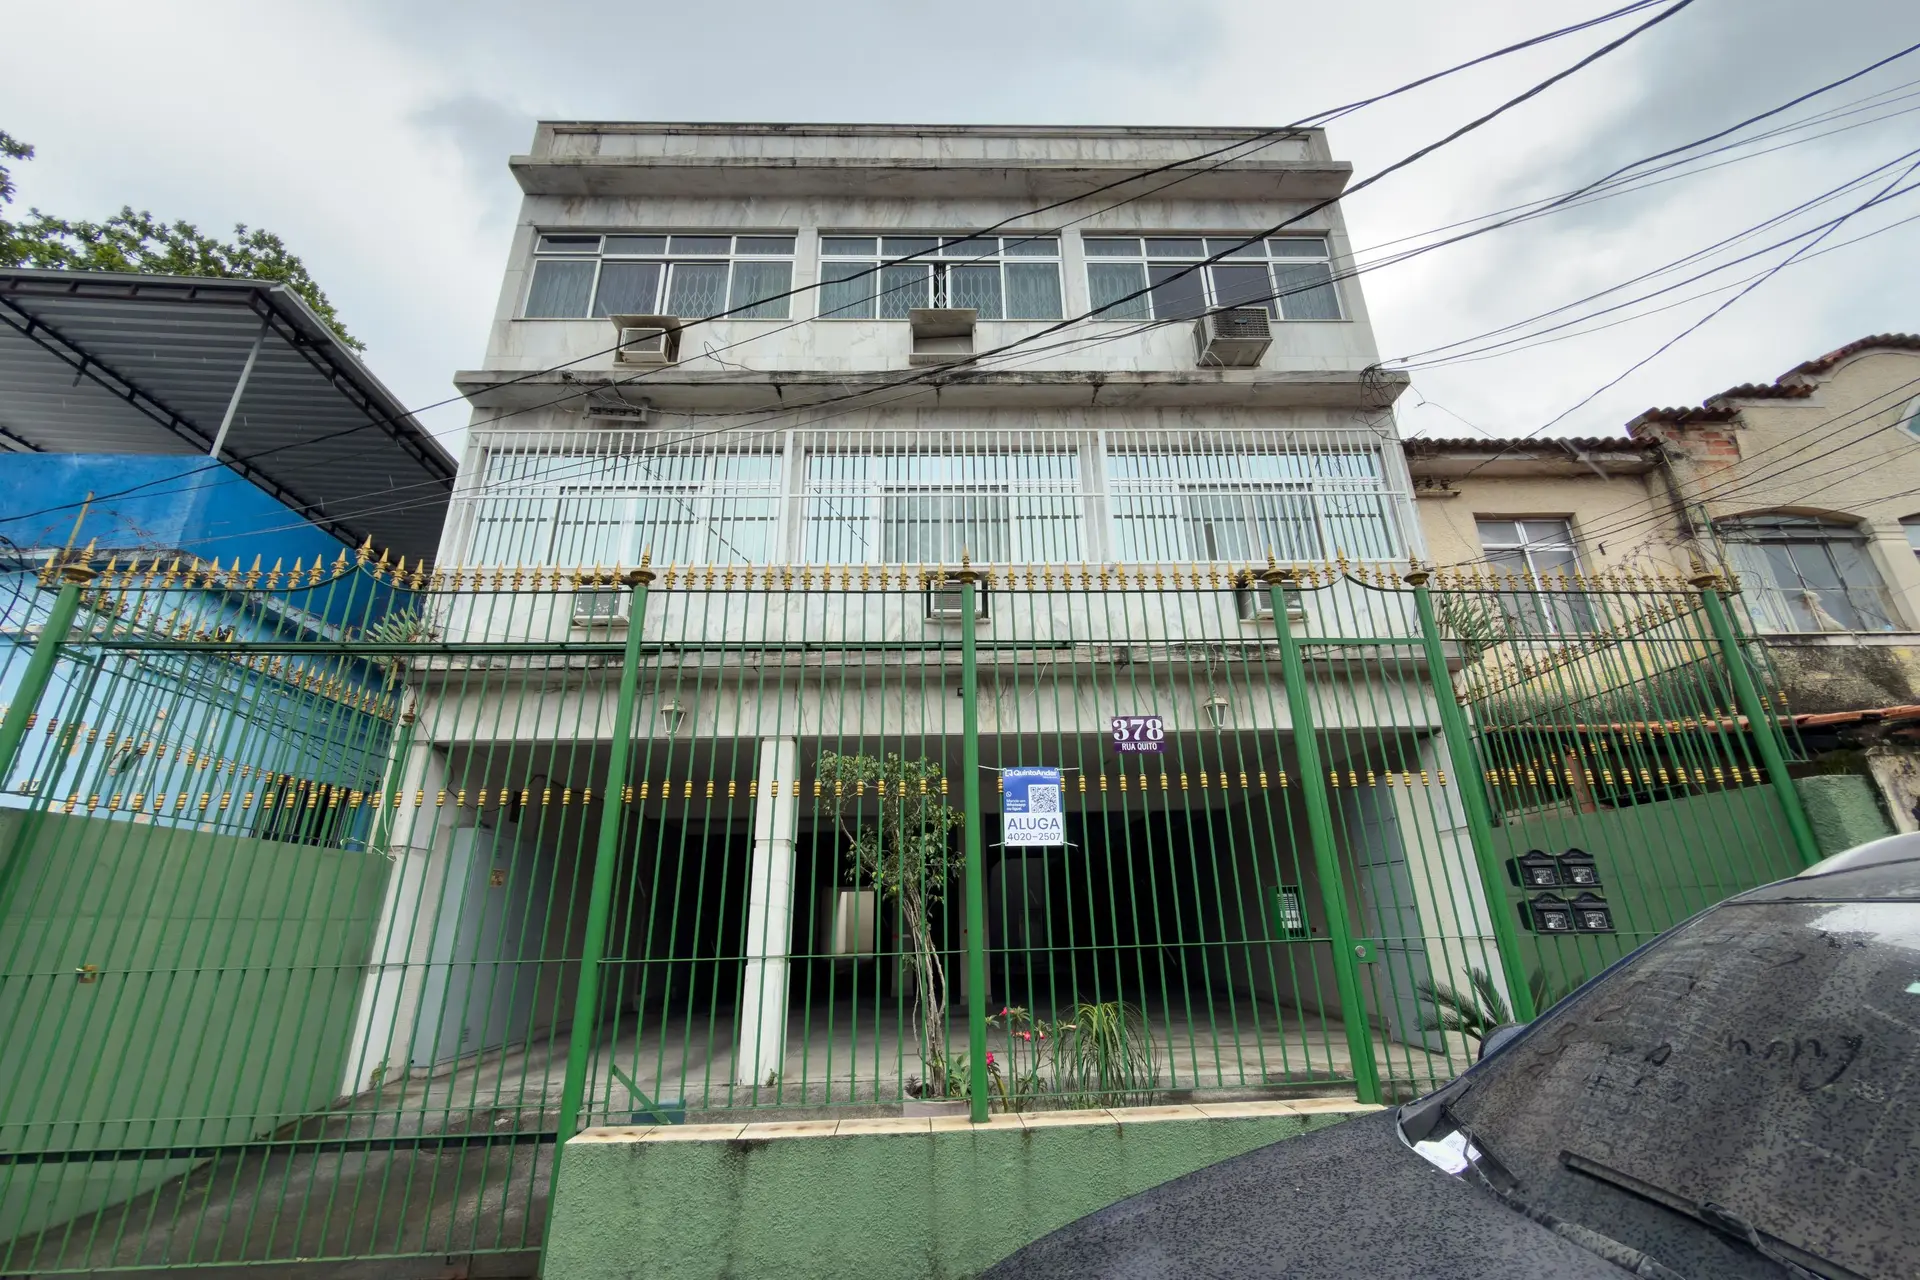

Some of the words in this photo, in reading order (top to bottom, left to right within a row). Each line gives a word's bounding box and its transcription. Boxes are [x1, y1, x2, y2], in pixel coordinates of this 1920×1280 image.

[1112, 719, 1164, 741] 378
[1121, 742, 1136, 750] RUA
[1137, 742, 1158, 750] QUITO
[1007, 817, 1060, 830] ALUGA
[1007, 832, 1061, 841] 4020-2507
